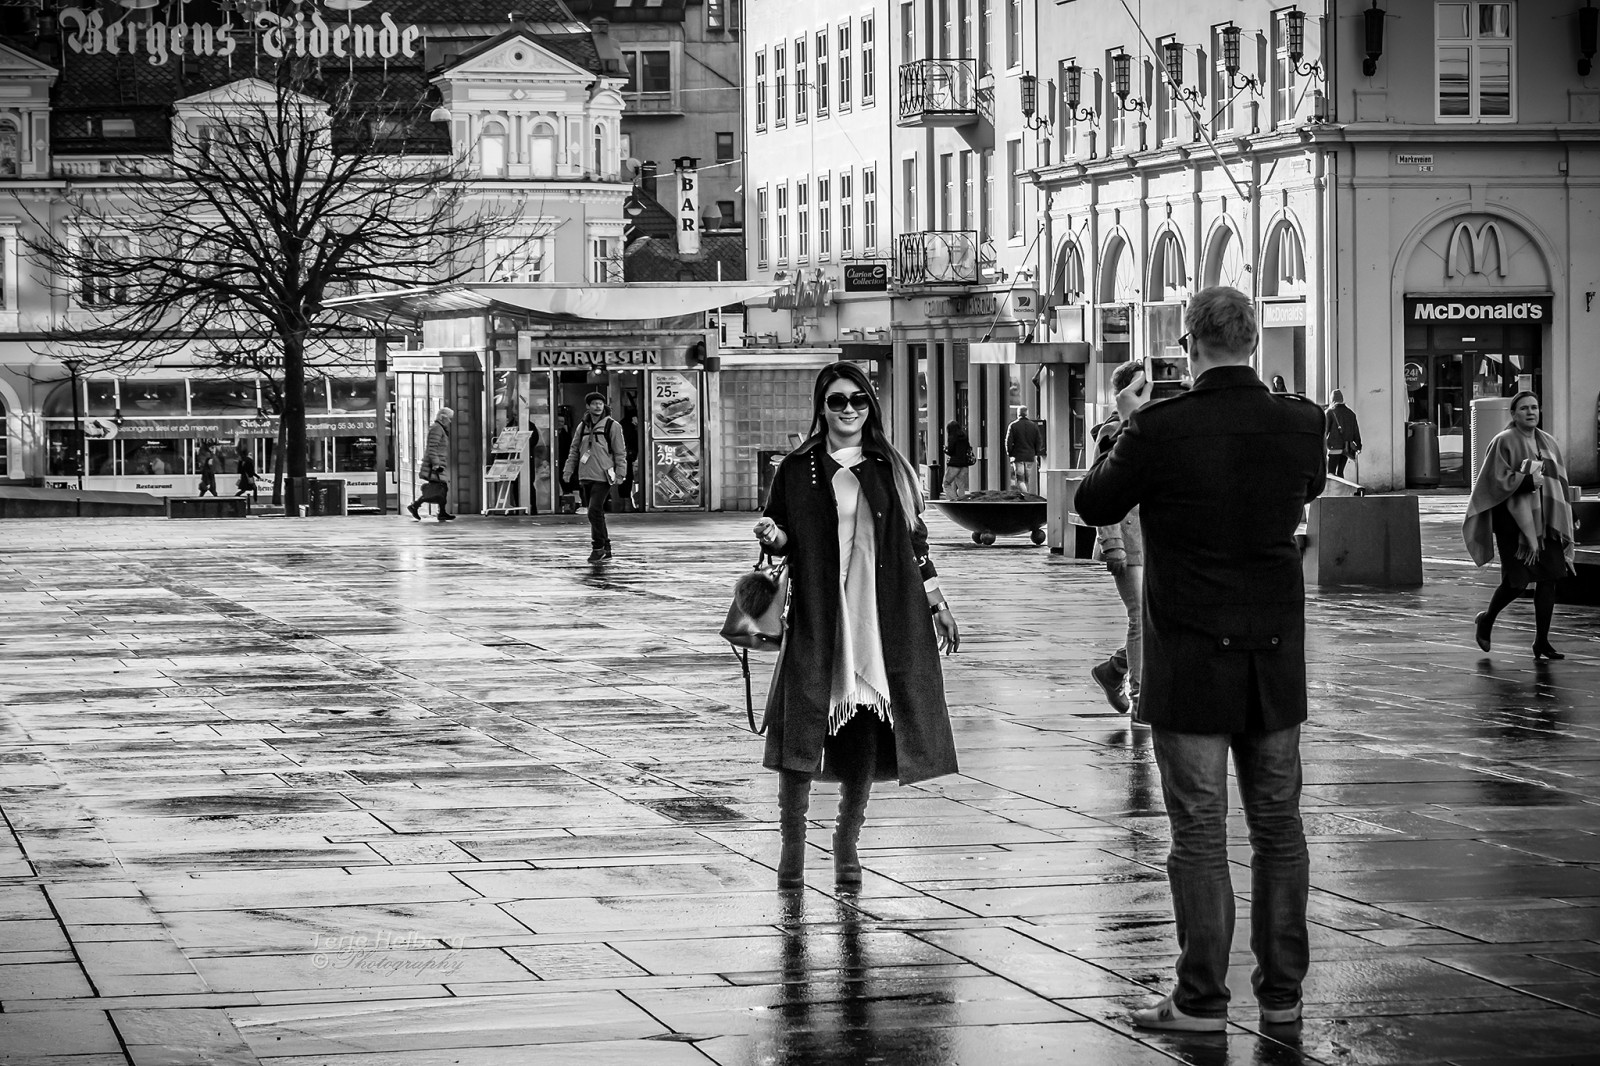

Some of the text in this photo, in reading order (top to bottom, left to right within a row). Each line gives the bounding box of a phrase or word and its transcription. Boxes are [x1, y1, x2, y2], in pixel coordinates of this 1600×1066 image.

[59, 8, 419, 66] Bergens Tidende
[1399, 155, 1432, 163] Markeveien
[681, 177, 695, 231] BAR
[847, 268, 872, 278] Clarion
[852, 277, 885, 285] Collection
[1414, 303, 1543, 319] McDonald's
[538, 350, 658, 365] NARVESEN
[365, 421, 375, 429] 30
[657, 445, 677, 453] 2 for
